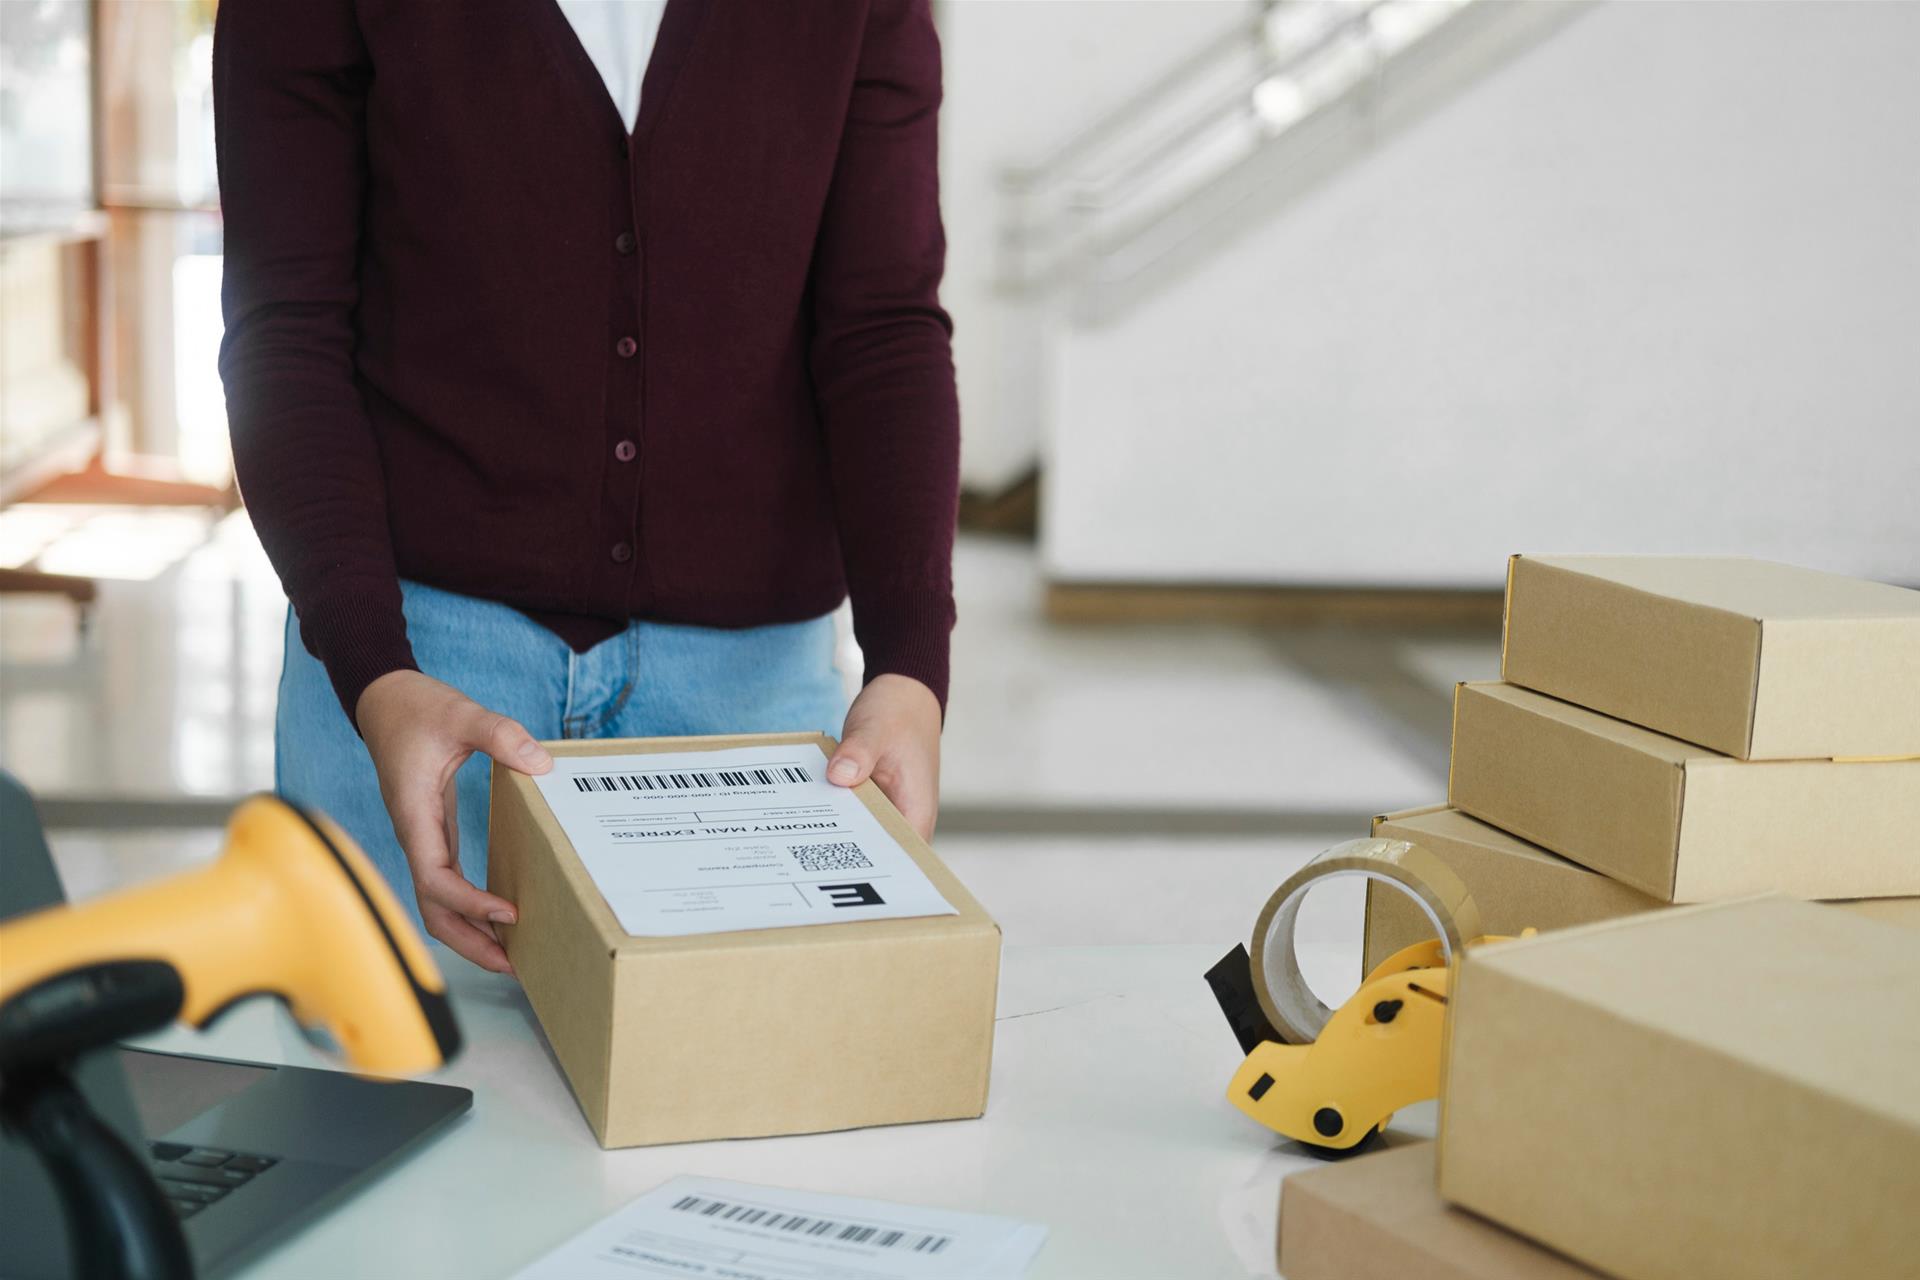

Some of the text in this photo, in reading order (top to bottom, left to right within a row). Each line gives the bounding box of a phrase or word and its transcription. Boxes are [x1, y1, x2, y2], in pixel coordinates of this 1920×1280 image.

[611, 821, 838, 838] PRIORITY MAIL EXPRESS
[818, 883, 886, 908] E
